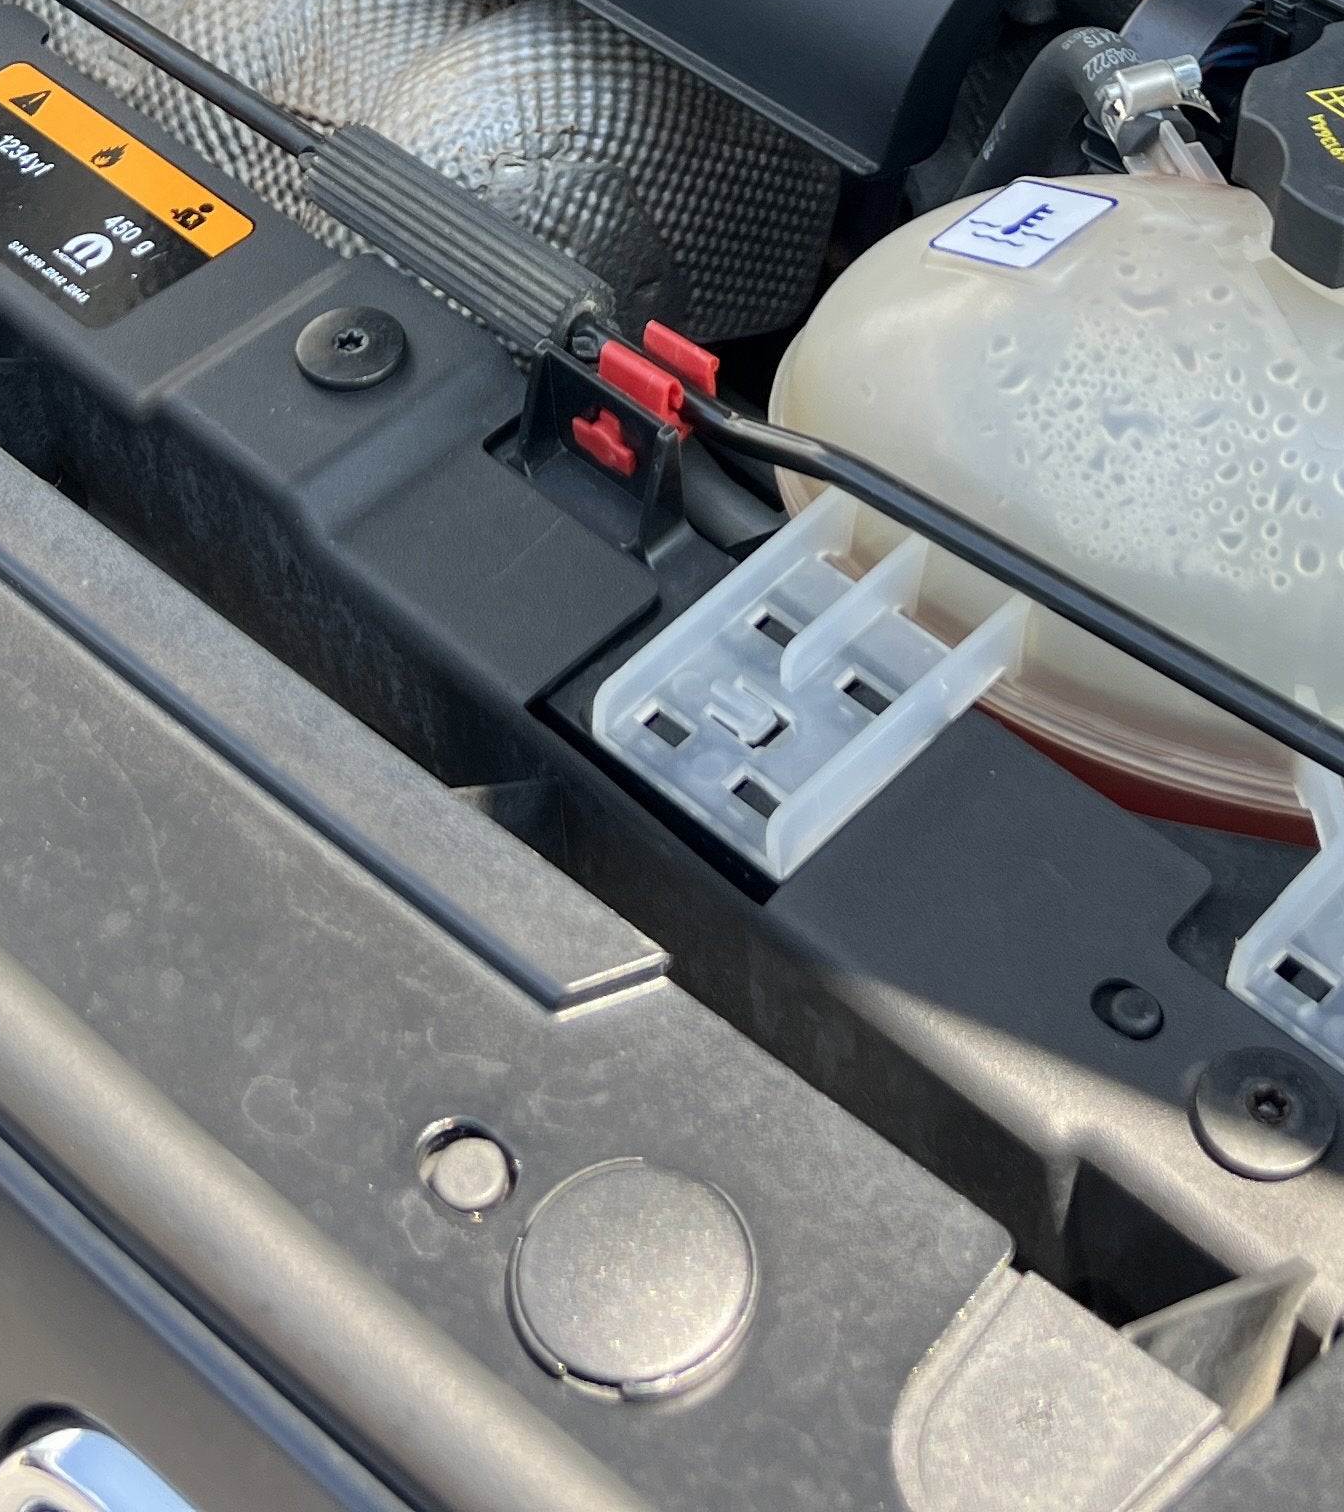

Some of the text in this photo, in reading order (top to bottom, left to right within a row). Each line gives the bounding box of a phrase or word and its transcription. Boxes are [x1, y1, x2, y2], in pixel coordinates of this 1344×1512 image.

[7, 240, 29, 257] SAE
[104, 215, 155, 258] 450 g
